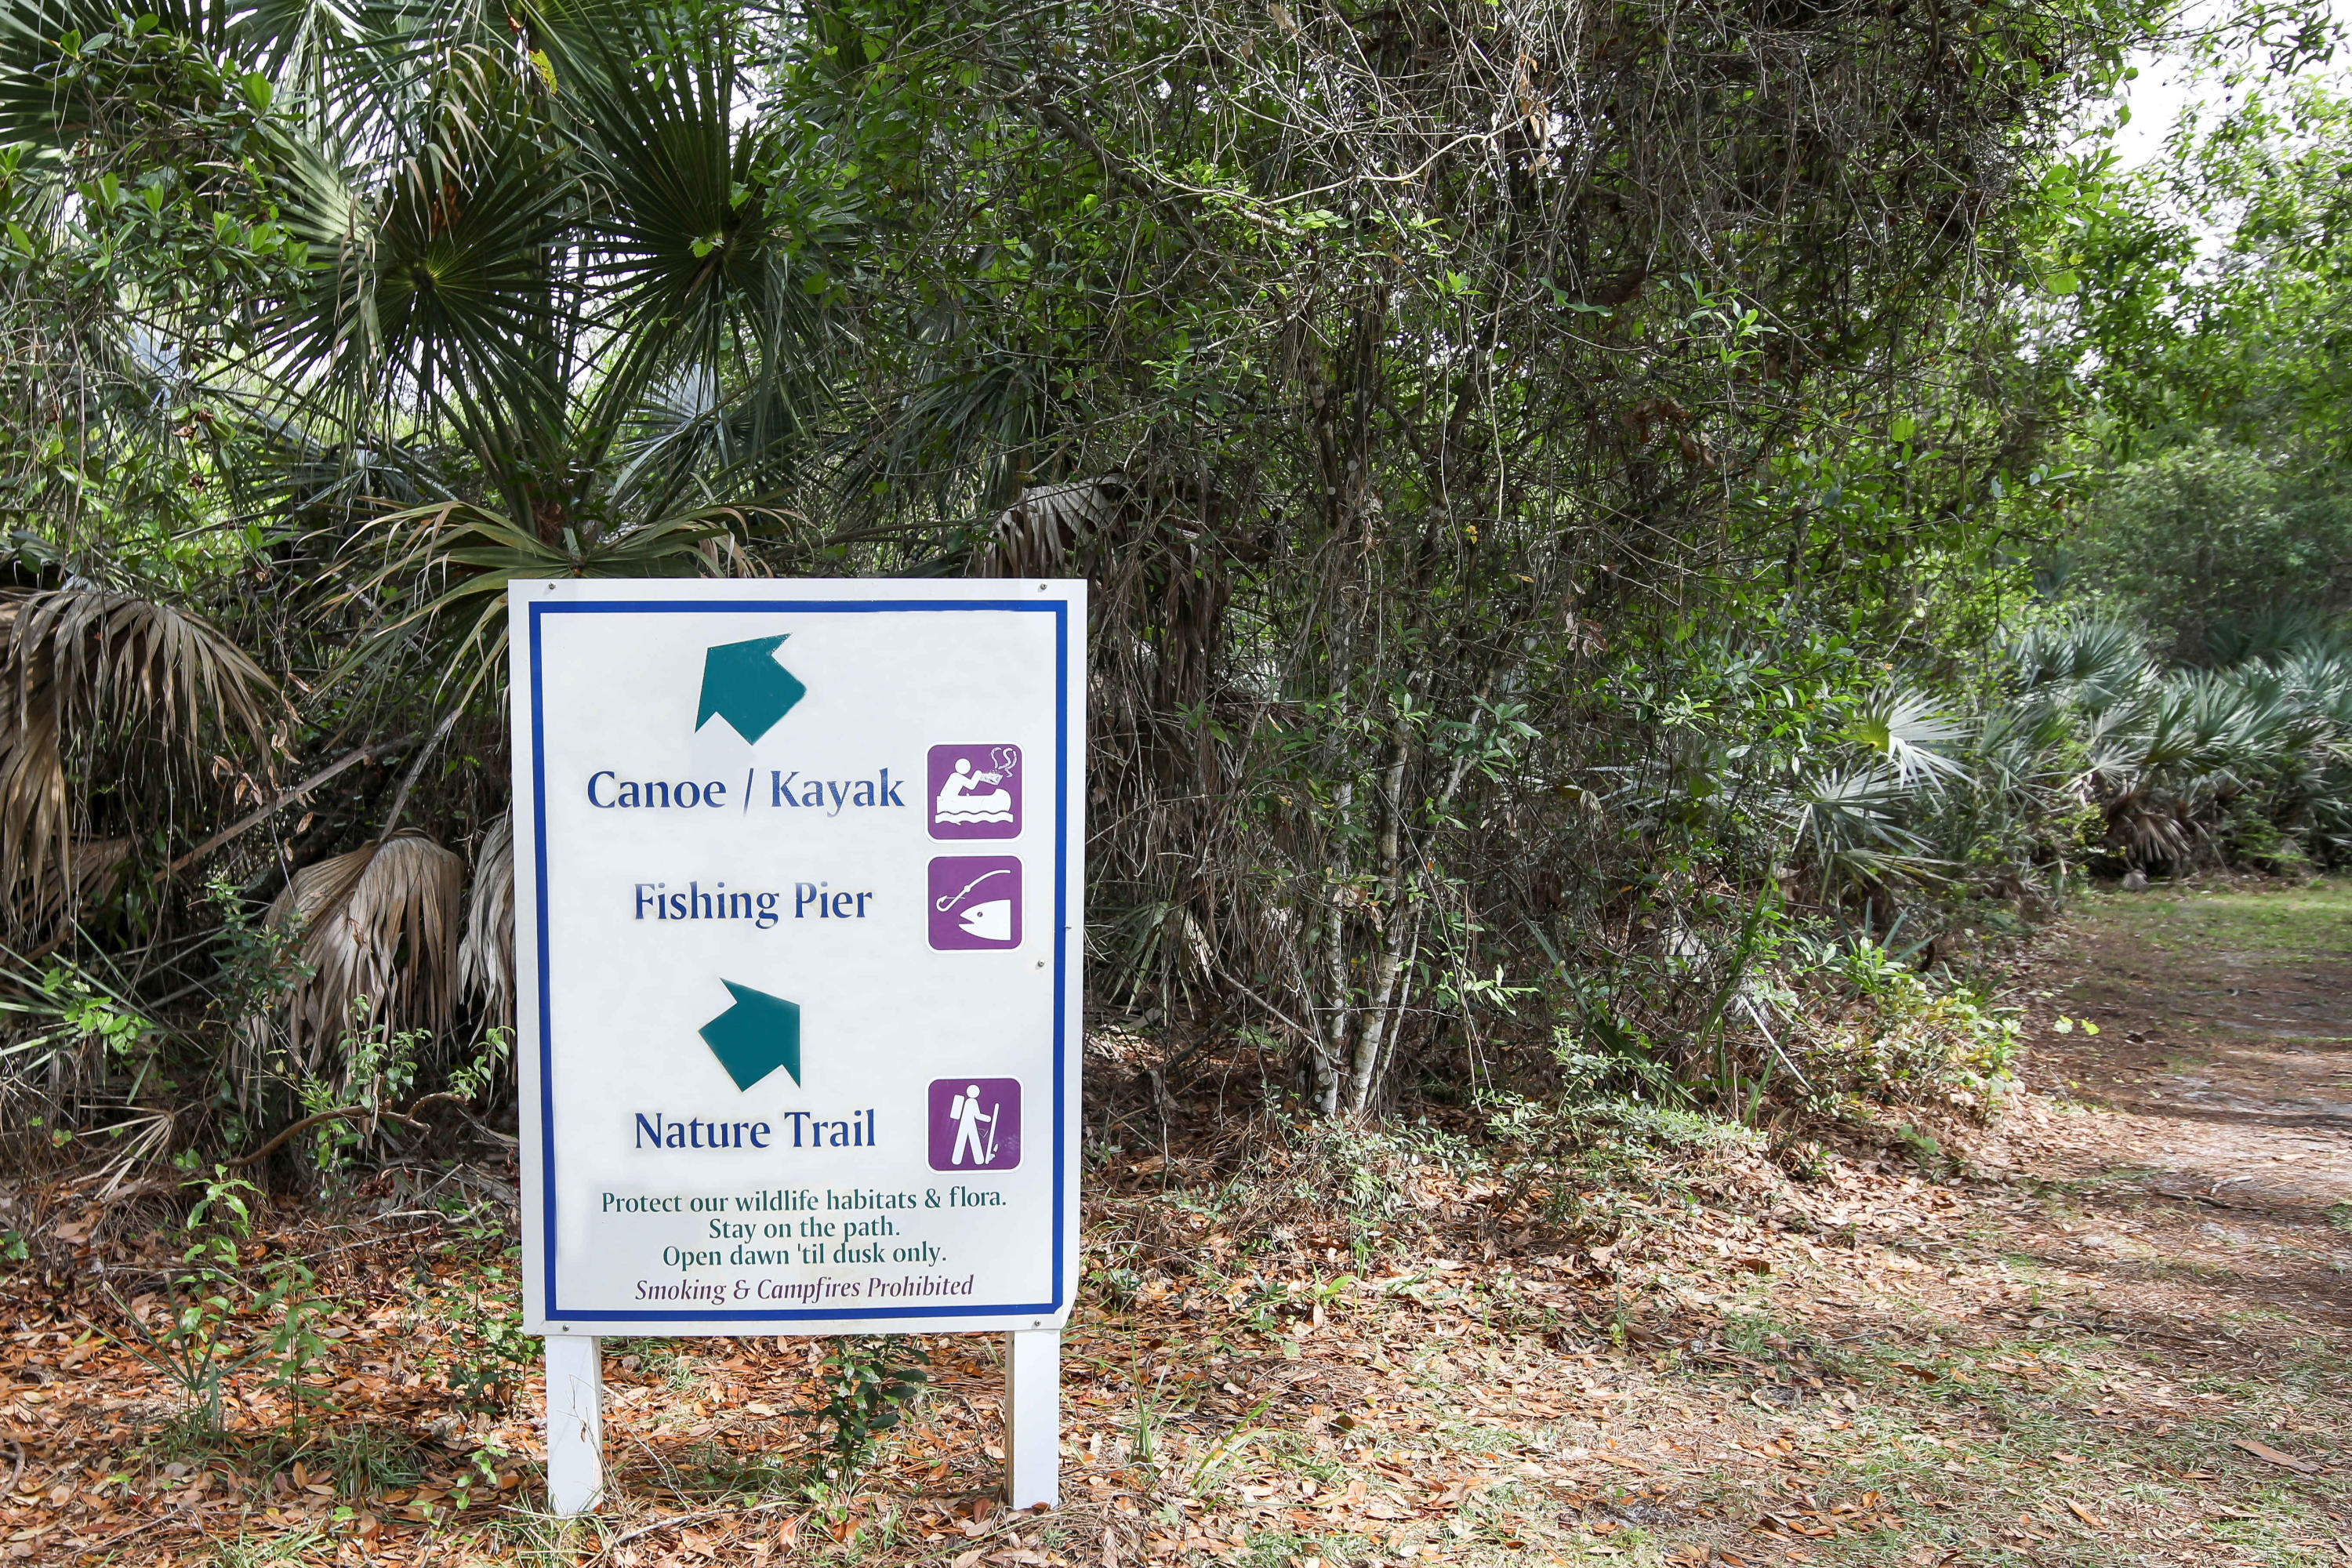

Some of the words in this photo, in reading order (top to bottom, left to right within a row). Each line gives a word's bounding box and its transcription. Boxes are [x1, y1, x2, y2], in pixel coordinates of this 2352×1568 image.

[588, 771, 726, 808] Canoe
[743, 768, 754, 815] /
[771, 768, 905, 816] Kayak
[635, 881, 779, 929] Fishing
[795, 882, 872, 918] Pier
[635, 1113, 770, 1148] Nature
[784, 1109, 875, 1147] Trail
[603, 1192, 682, 1212] Protect
[690, 1198, 728, 1212] our
[735, 1189, 818, 1211] wildlife
[827, 1189, 916, 1210] habitats
[925, 1189, 941, 1208] &
[949, 1186, 1006, 1207] flora.
[710, 1218, 756, 1243] Stay
[764, 1224, 791, 1238] on
[800, 1217, 835, 1237] the
[843, 1215, 899, 1243] path.
[663, 1246, 721, 1270] Open
[731, 1244, 789, 1265] dawn
[798, 1243, 824, 1264] 'til
[833, 1242, 885, 1263] dusk
[893, 1241, 946, 1267] only.
[635, 1279, 726, 1305] Smoking
[734, 1279, 750, 1299] &
[758, 1276, 860, 1304] Campfires
[868, 1274, 974, 1297] Prohibited
